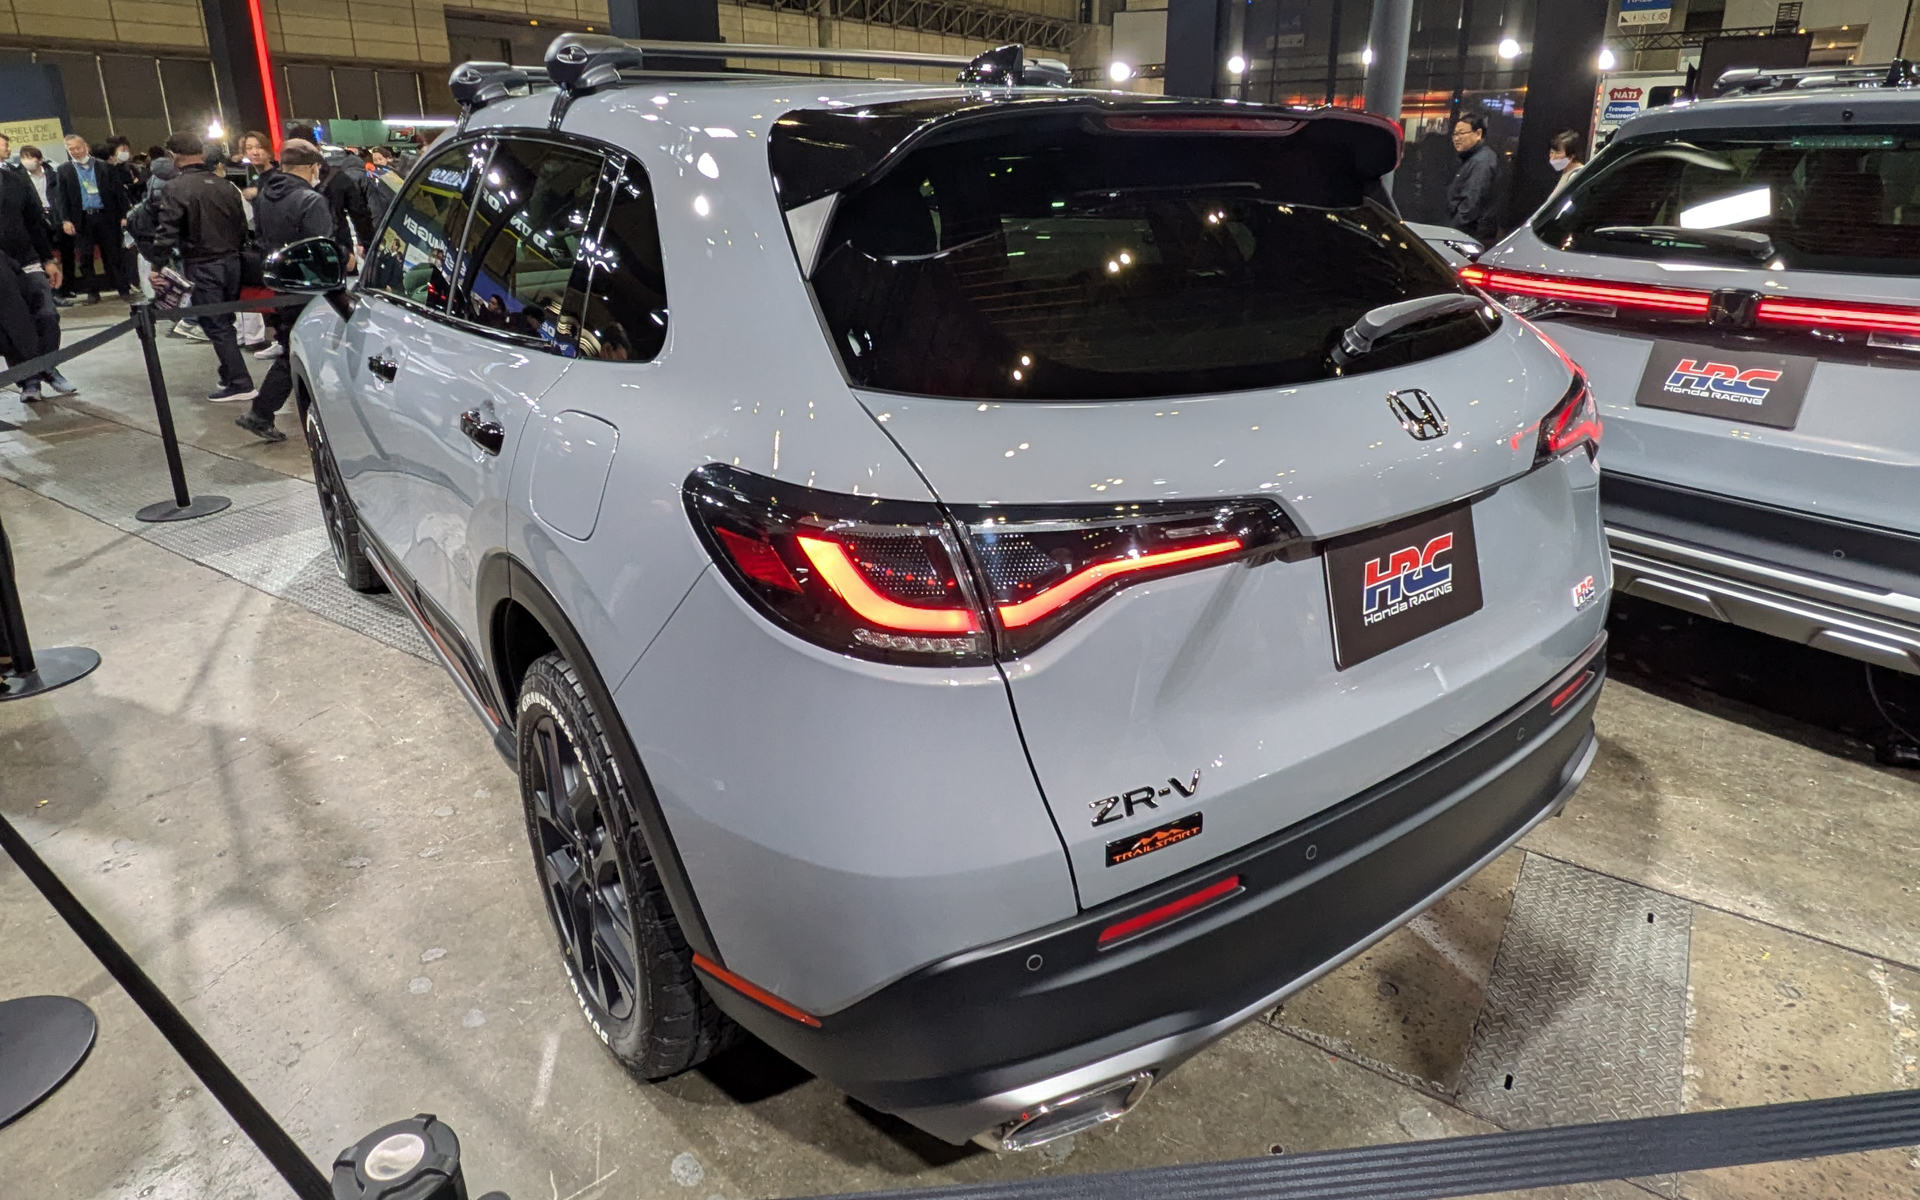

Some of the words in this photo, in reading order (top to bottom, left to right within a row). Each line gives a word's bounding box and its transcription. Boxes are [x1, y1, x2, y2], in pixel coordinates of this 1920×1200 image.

[1613, 91, 1638, 99] NATS
[4, 124, 49, 134] PRELUDE
[1663, 384, 1709, 398] Honda
[1711, 391, 1763, 406] RACING
[1665, 358, 1783, 399] HRC
[1363, 531, 1453, 615] HRC
[1363, 601, 1408, 627] Honda
[1409, 582, 1453, 608] RACING
[521, 691, 574, 744] GRANDTREK
[1088, 768, 1201, 827] ZR-V
[1112, 826, 1200, 862] TRAILSPORT
